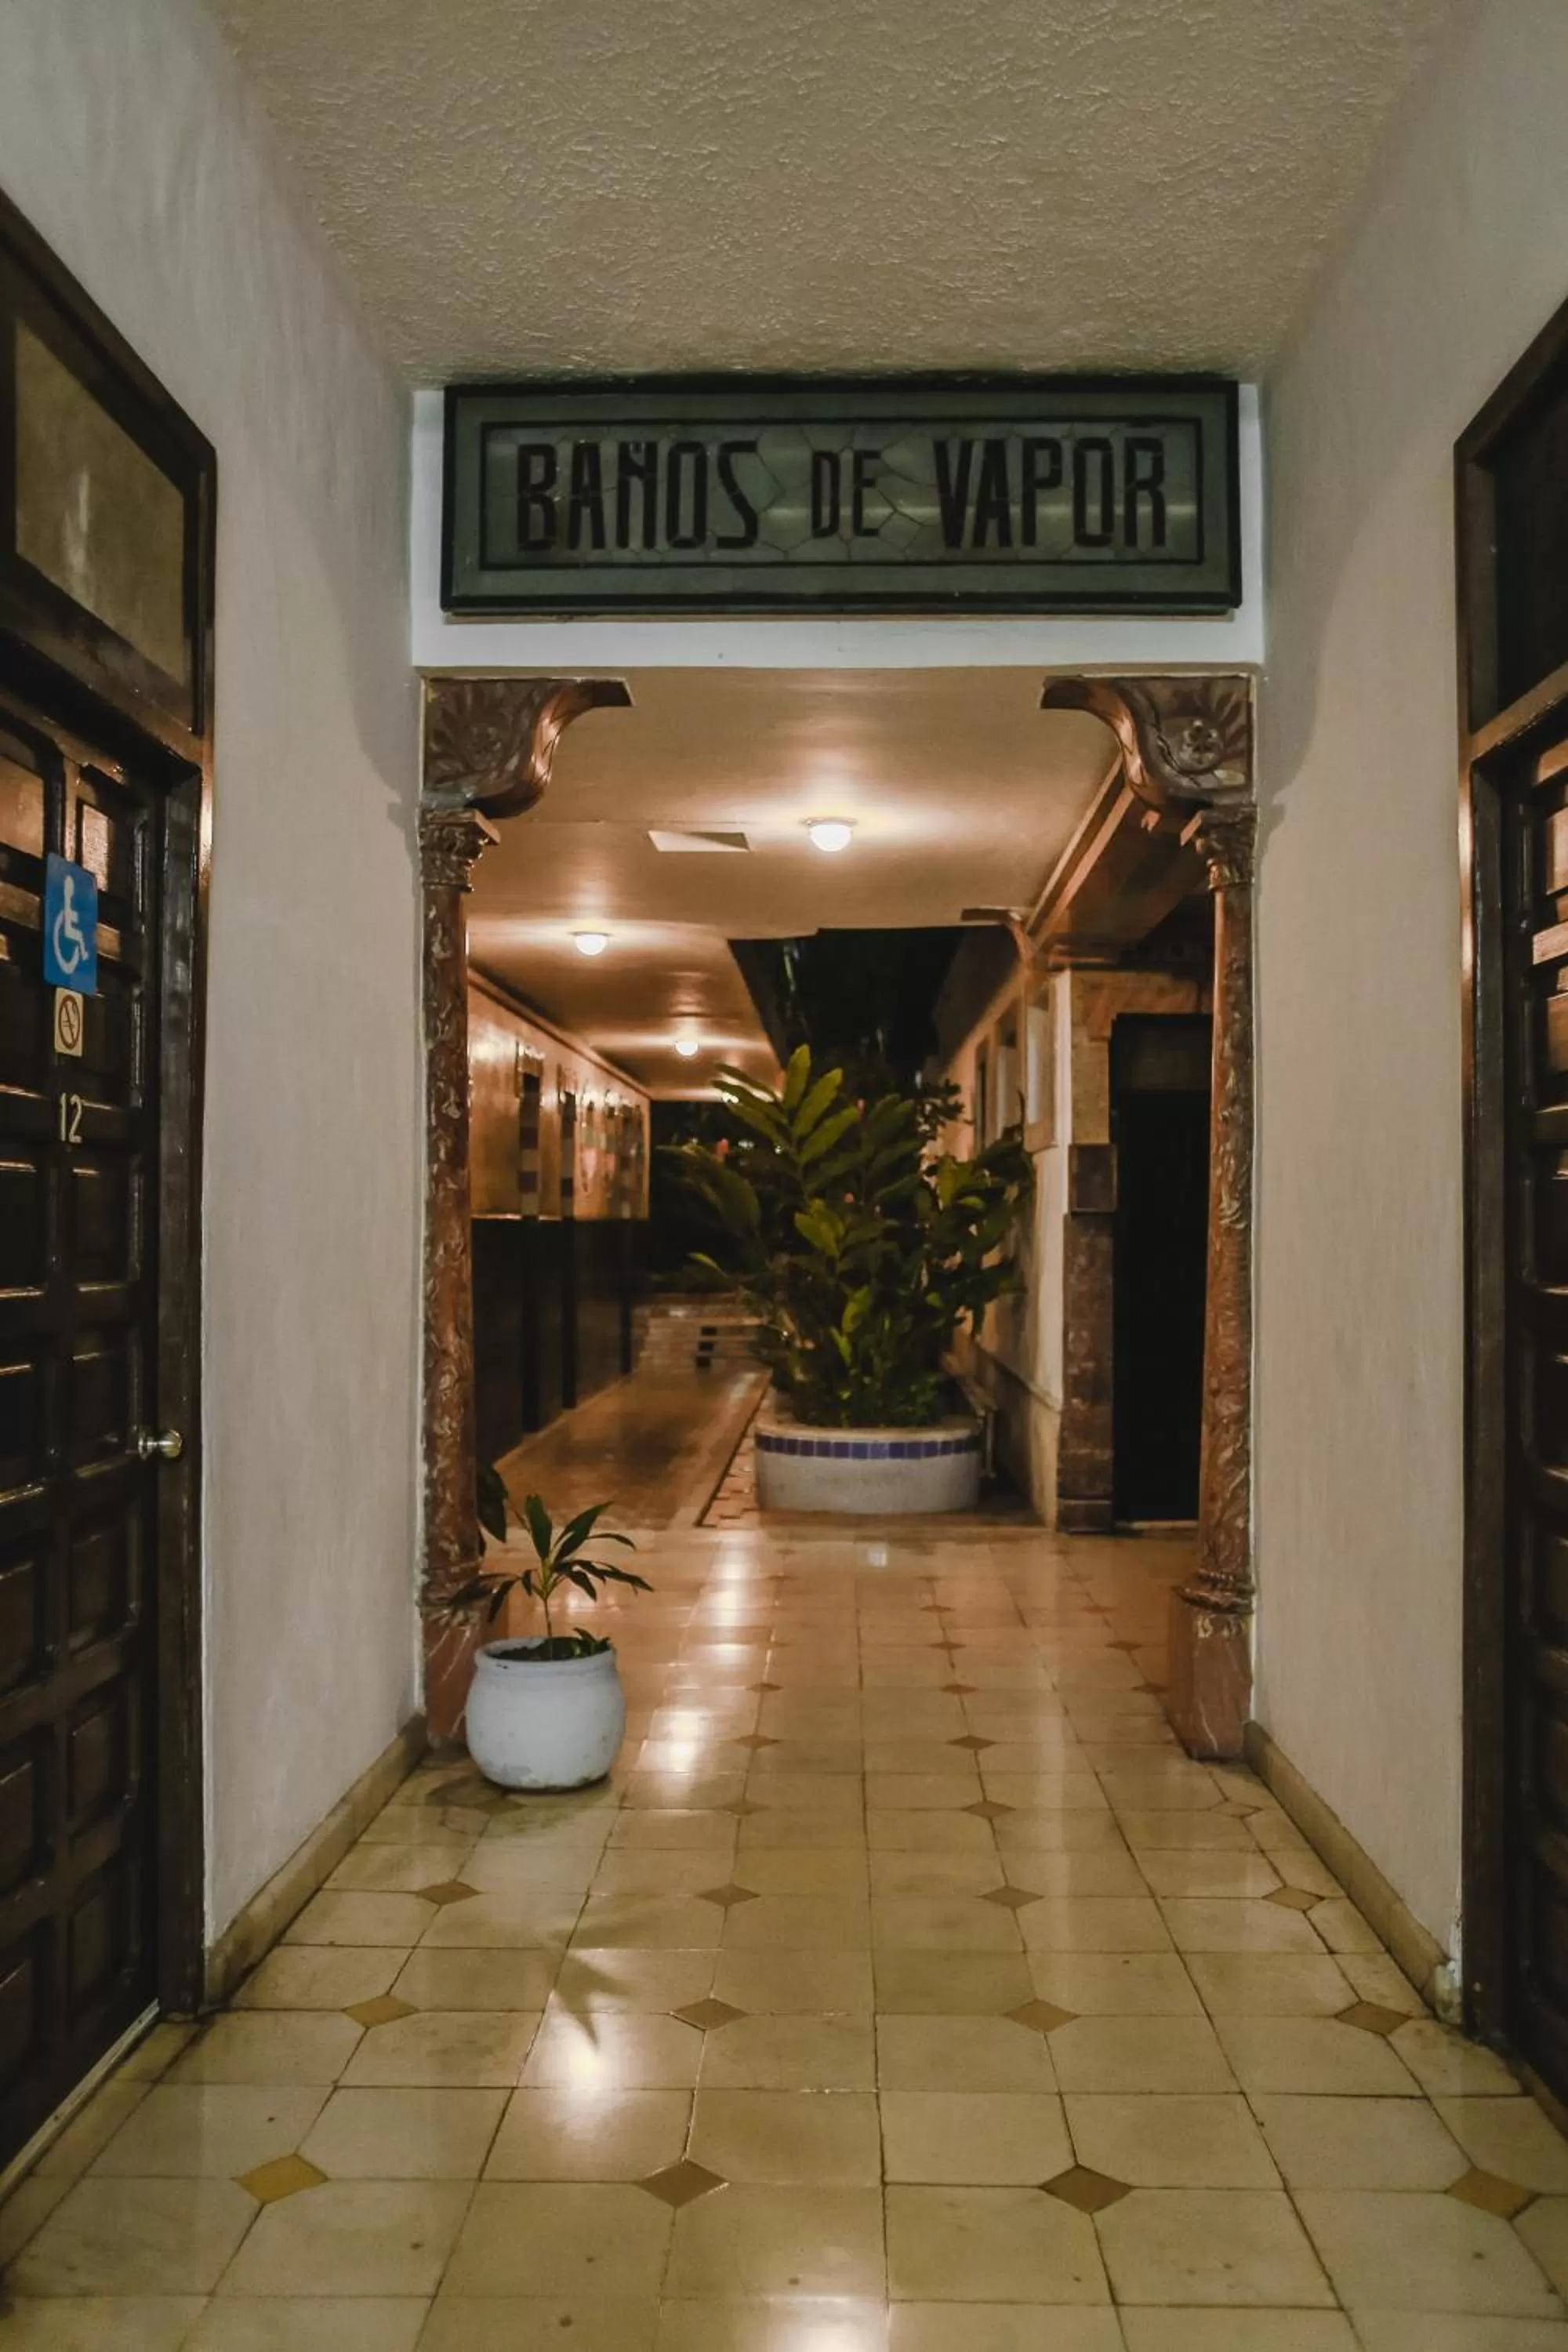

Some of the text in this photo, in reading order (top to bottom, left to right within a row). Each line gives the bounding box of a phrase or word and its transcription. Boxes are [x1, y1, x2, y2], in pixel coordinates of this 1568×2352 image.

[811, 451, 880, 538] DE
[933, 437, 1166, 549] VAPOR
[60, 1092, 82, 1144] 12
